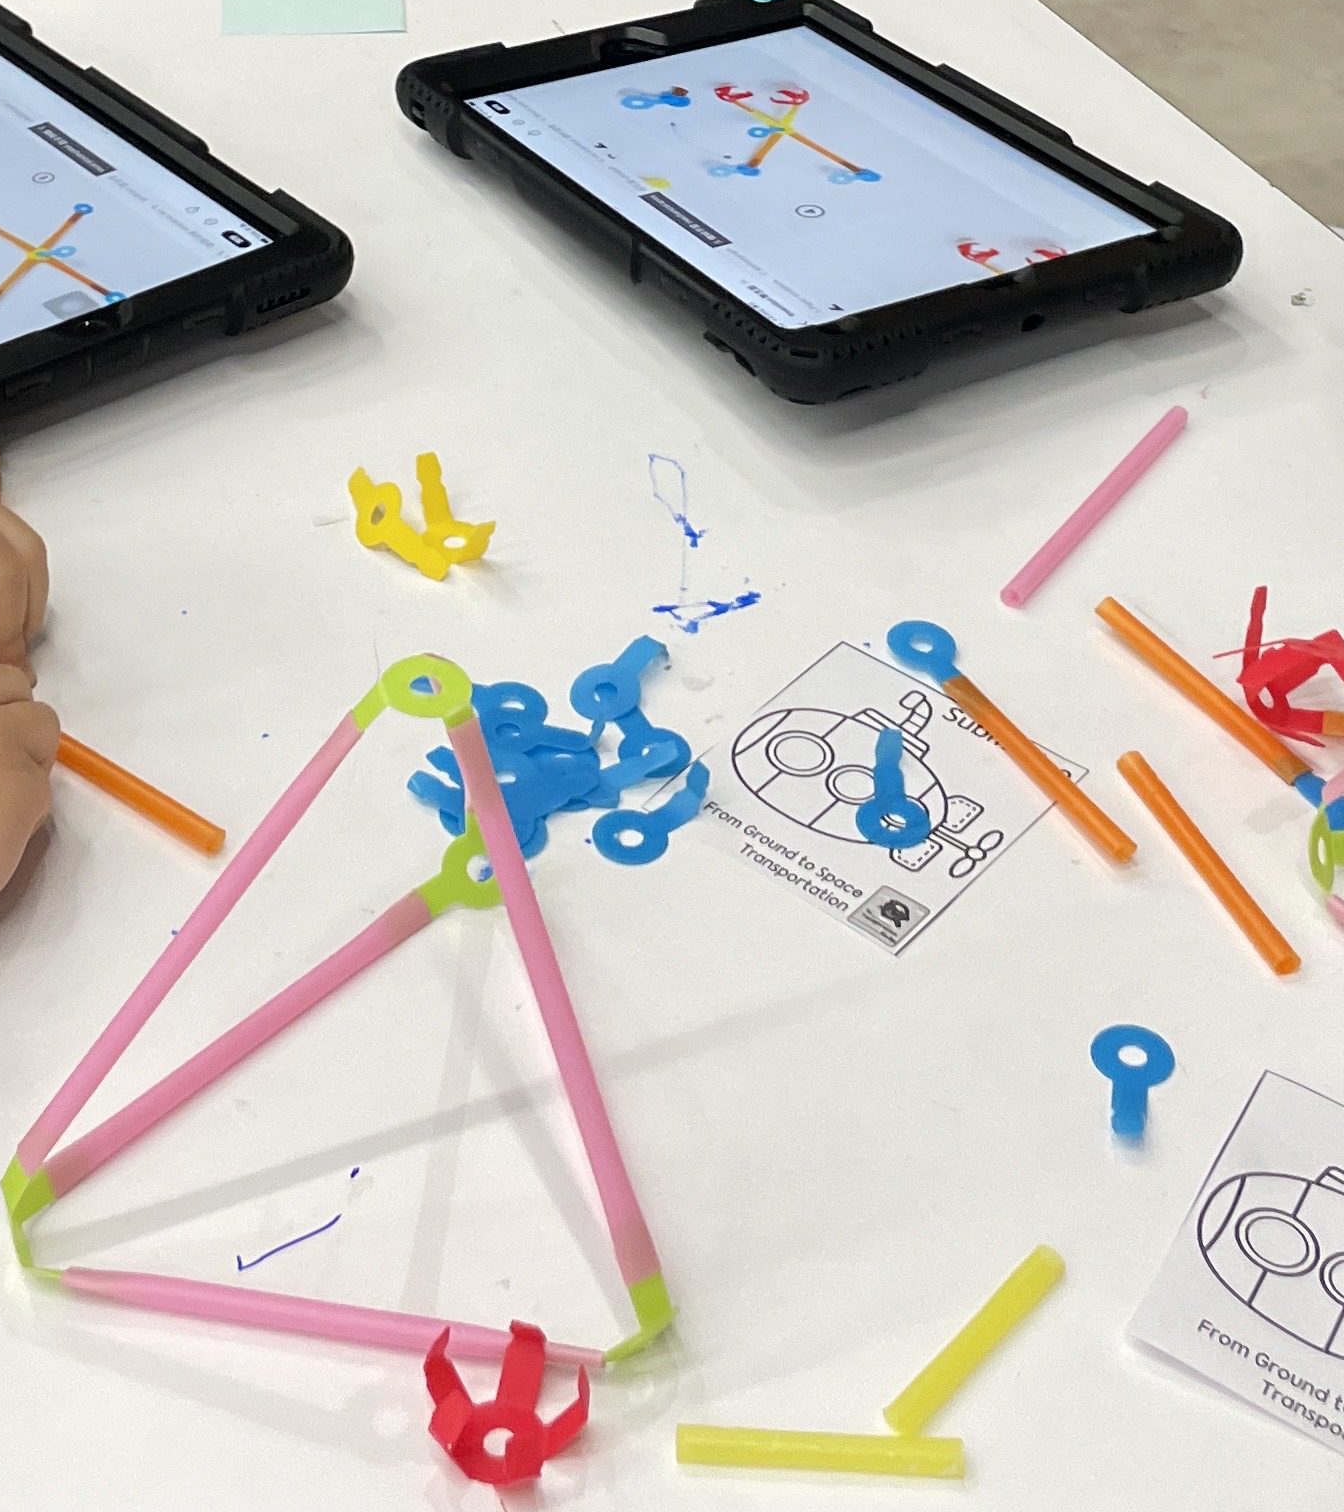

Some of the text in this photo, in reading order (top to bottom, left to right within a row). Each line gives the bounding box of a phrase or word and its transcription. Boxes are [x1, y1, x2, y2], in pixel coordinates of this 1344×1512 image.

[703, 801, 863, 898] From Ground to Space
[739, 842, 849, 912] Transportation
[1197, 1319, 1250, 1359] From
[1255, 1352, 1330, 1403] Ground
